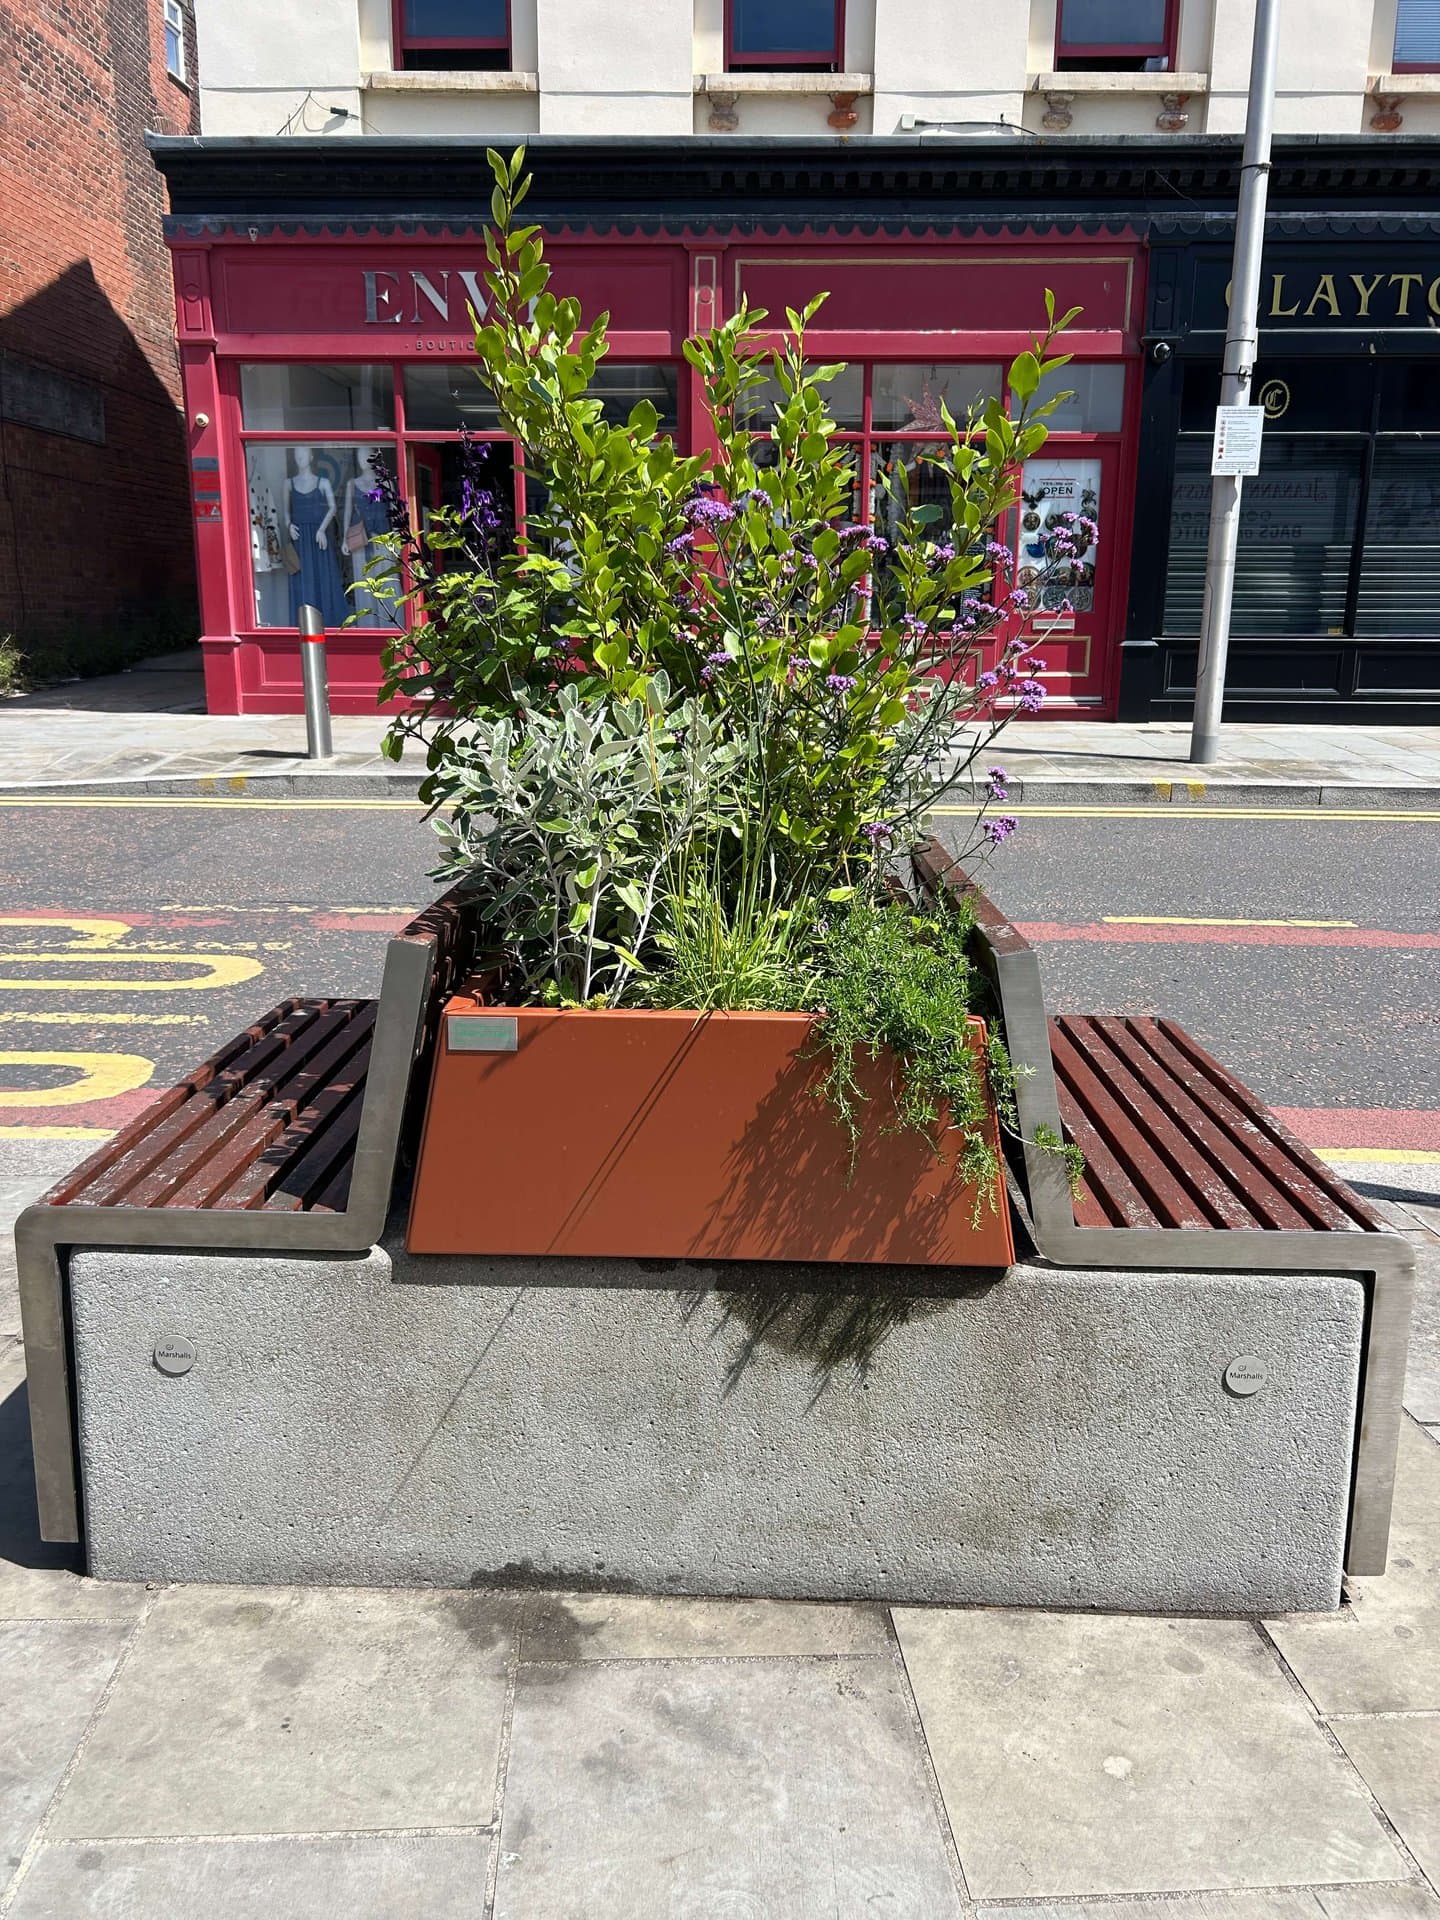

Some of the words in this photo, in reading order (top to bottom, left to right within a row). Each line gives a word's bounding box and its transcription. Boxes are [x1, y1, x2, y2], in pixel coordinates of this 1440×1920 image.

[1225, 273, 1440, 316] LAYT
[1043, 486, 1073, 495] OPEN
[158, 1350, 192, 1359] Marshalls
[1230, 1371, 1264, 1380] Marshalls
